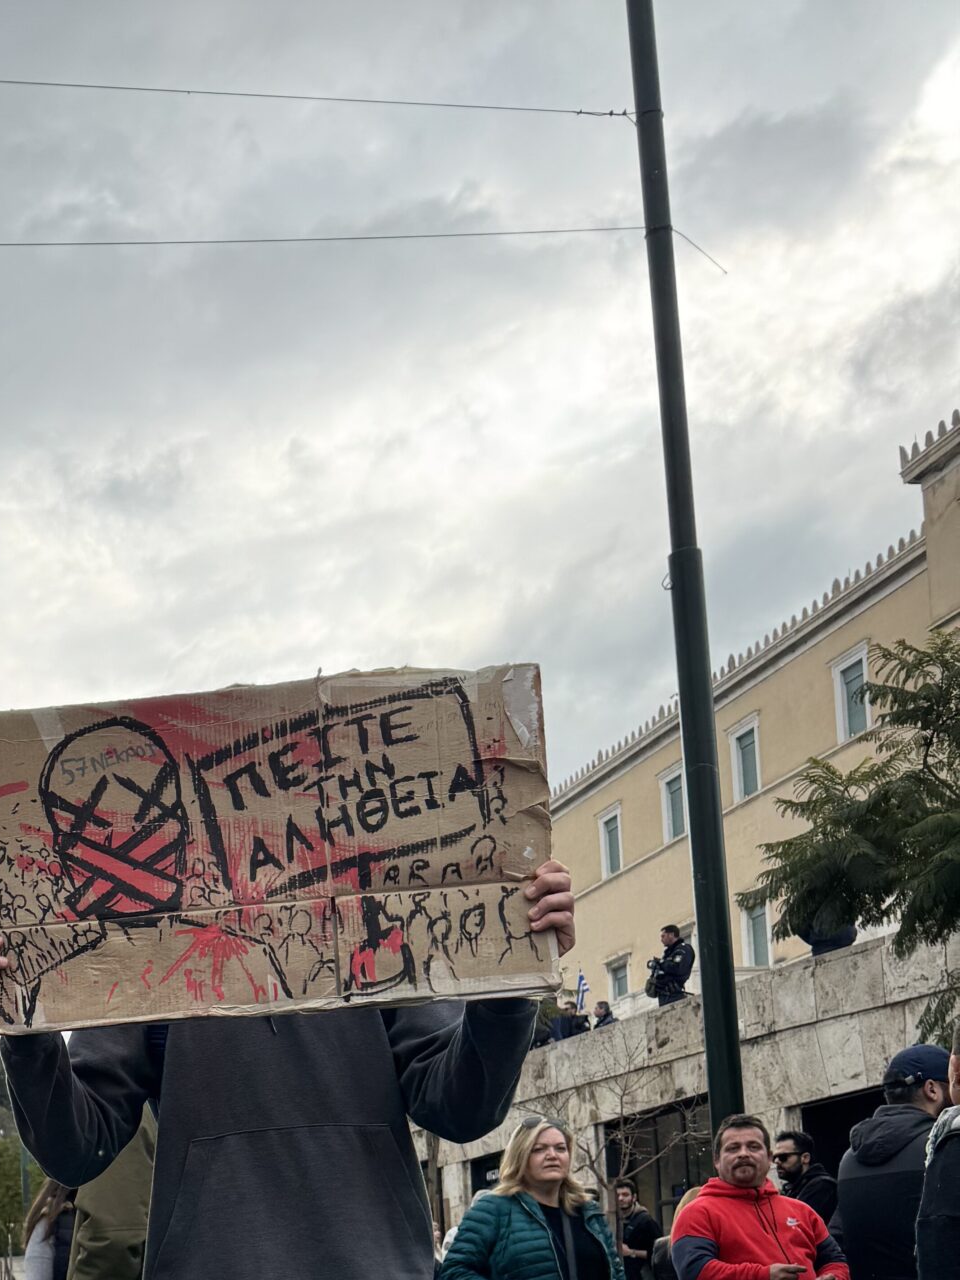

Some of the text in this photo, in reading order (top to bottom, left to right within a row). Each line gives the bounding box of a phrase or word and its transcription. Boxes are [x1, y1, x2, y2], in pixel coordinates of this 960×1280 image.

[60, 757, 88, 786] 57
[222, 705, 421, 812] ΠΕΙΤΕ
[302, 752, 396, 808] ΤΗΝ
[249, 763, 483, 882] ΑΛΗΘΕΙΑ
